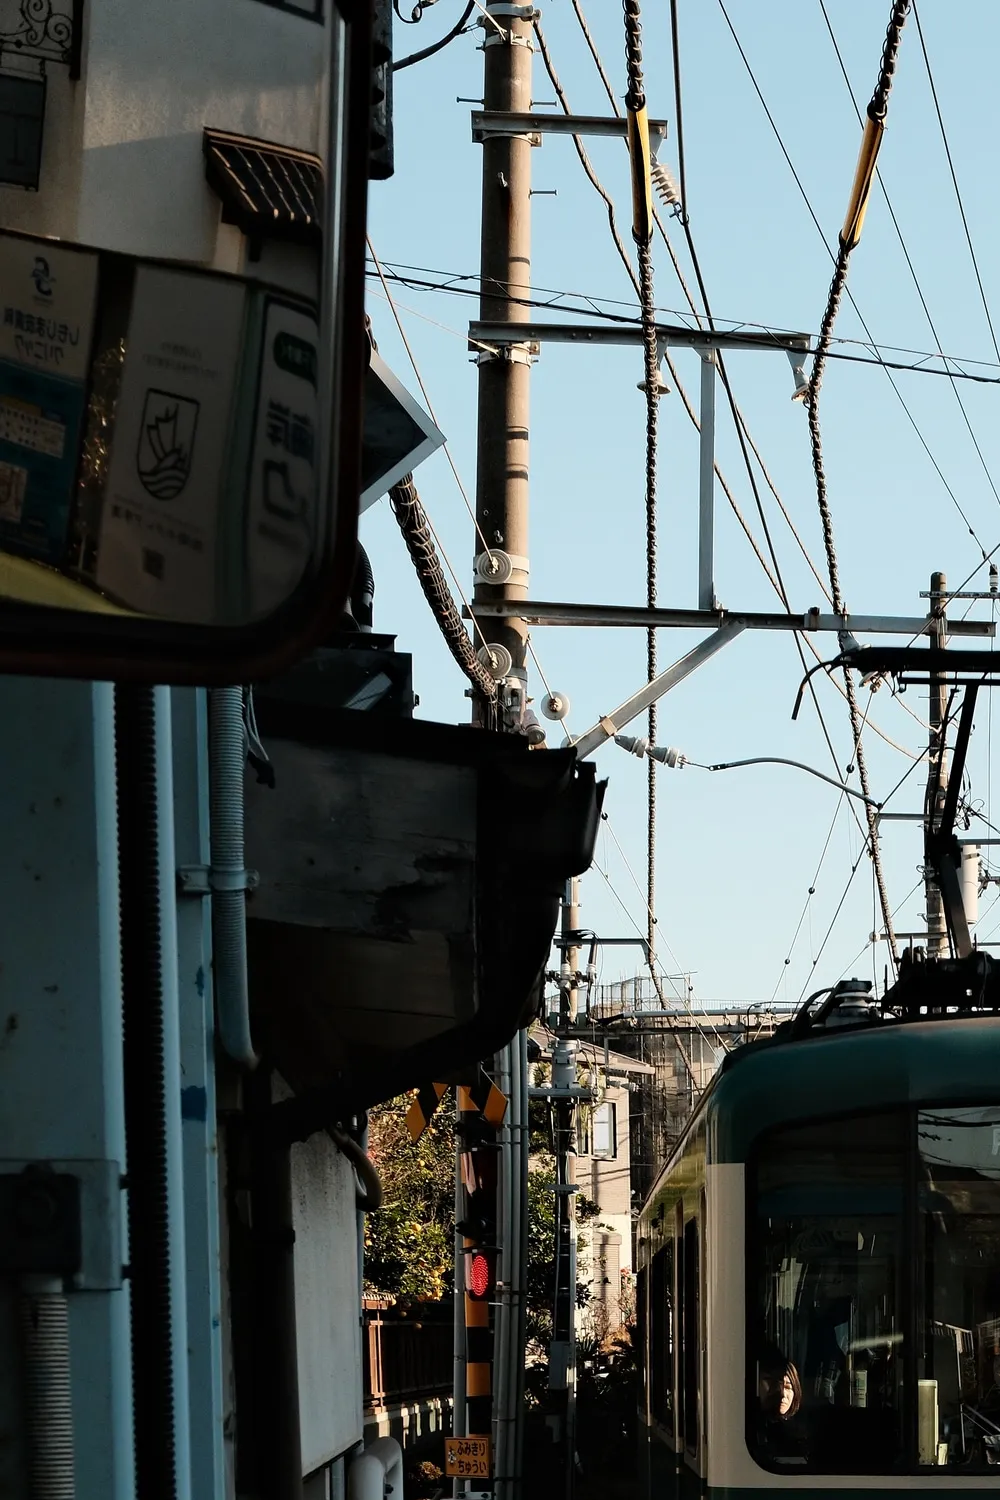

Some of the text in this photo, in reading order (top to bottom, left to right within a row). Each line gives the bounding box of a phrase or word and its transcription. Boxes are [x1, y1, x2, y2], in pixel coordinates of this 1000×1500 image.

[457, 1441, 487, 1457] ふみきり
[457, 1460, 487, 1474] ちゅうい
